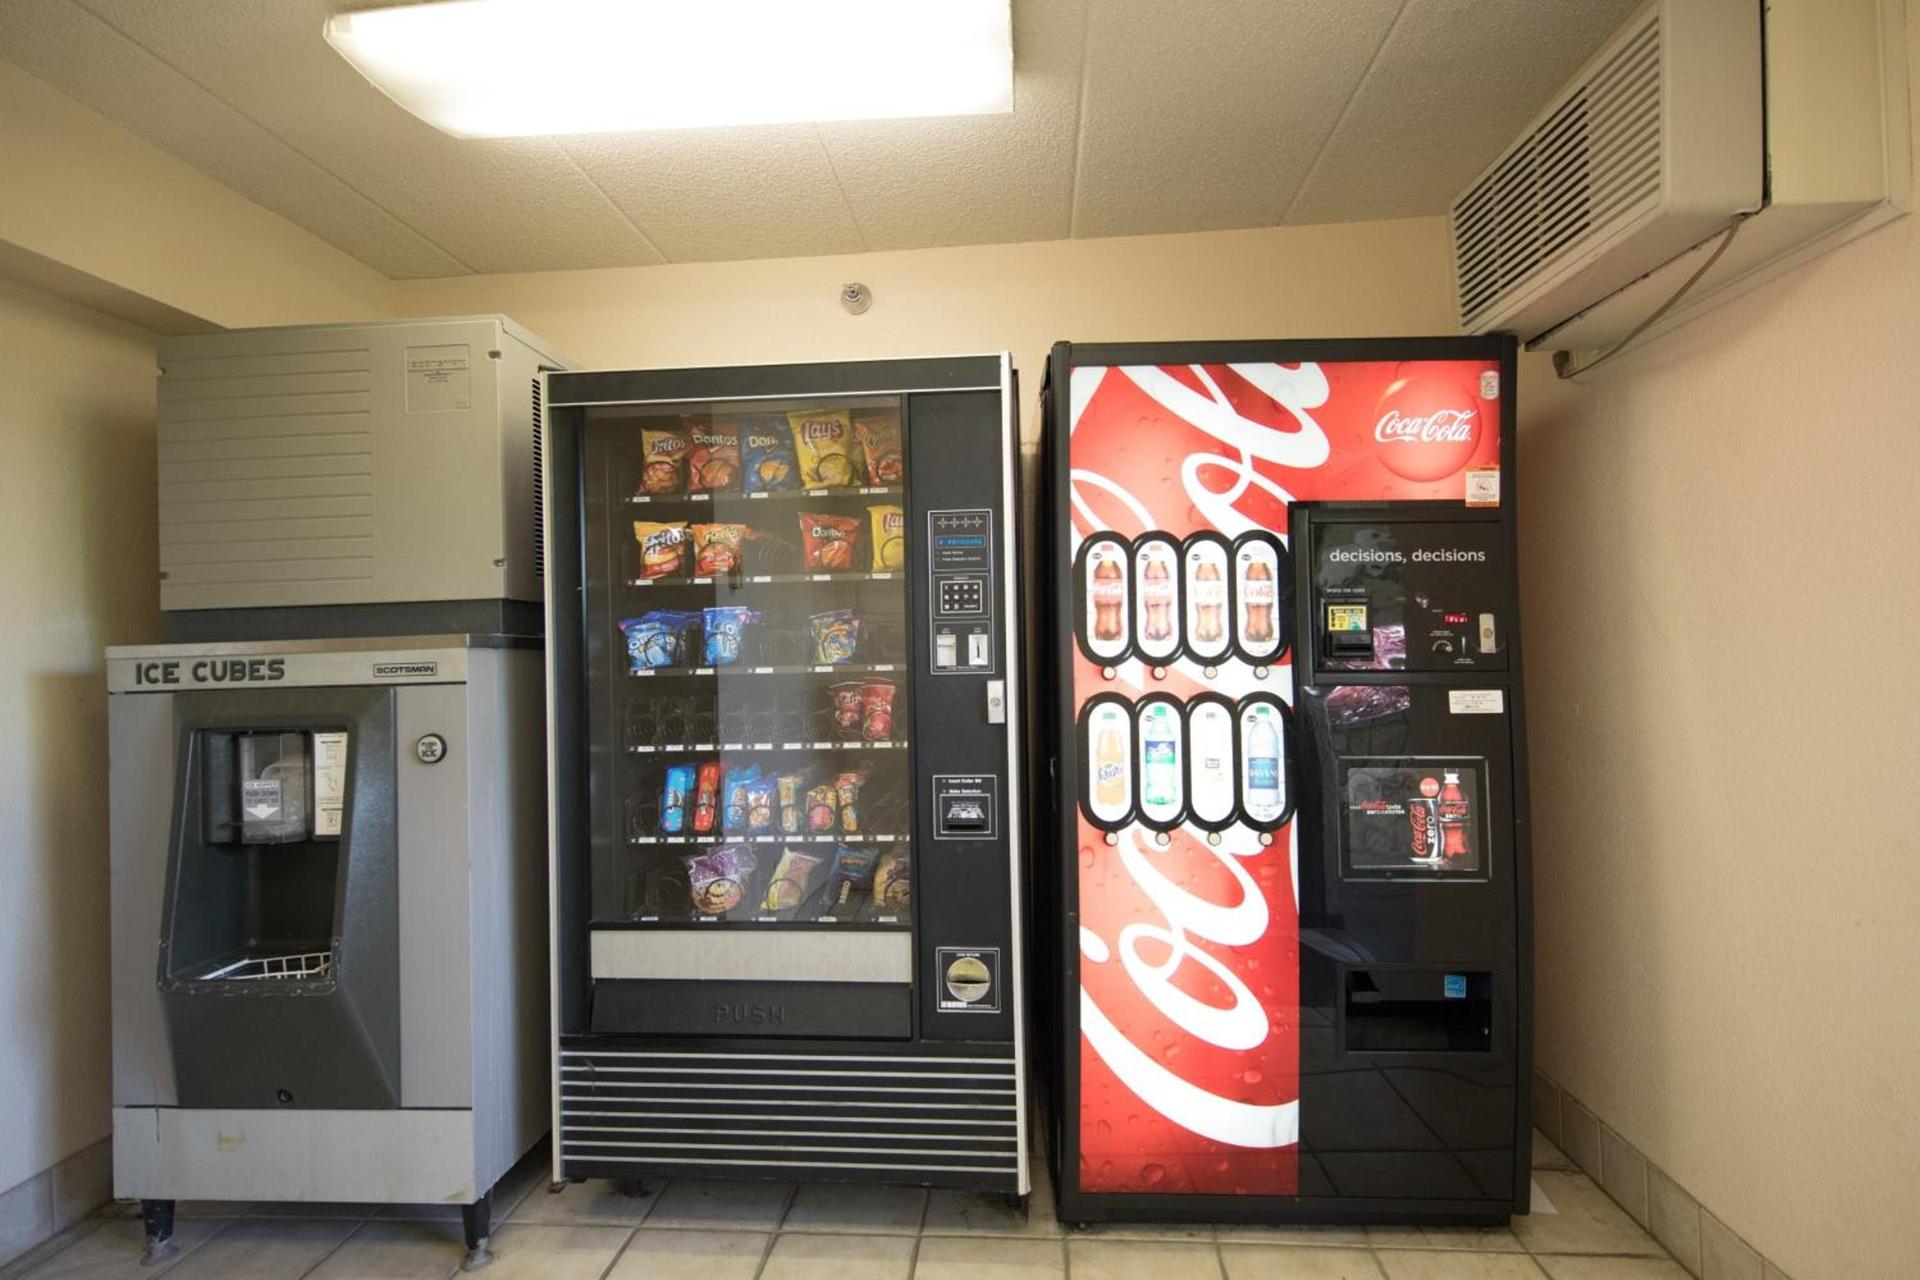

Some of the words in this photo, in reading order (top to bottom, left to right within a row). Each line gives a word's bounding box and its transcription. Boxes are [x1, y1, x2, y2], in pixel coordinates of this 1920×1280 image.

[803, 419, 842, 442] Lay's
[1374, 409, 1478, 443] Coca-Cola
[692, 434, 738, 446] Doritos
[1329, 548, 1408, 564] decisions,
[1411, 548, 1486, 562] decisions
[135, 661, 181, 685] ICE
[191, 658, 286, 682] CUBES
[375, 664, 436, 675] SCOTSMAN
[1410, 805, 1427, 856] Coca-Cola
[1426, 815, 1436, 845] zero
[715, 1004, 786, 1024] PUSH
